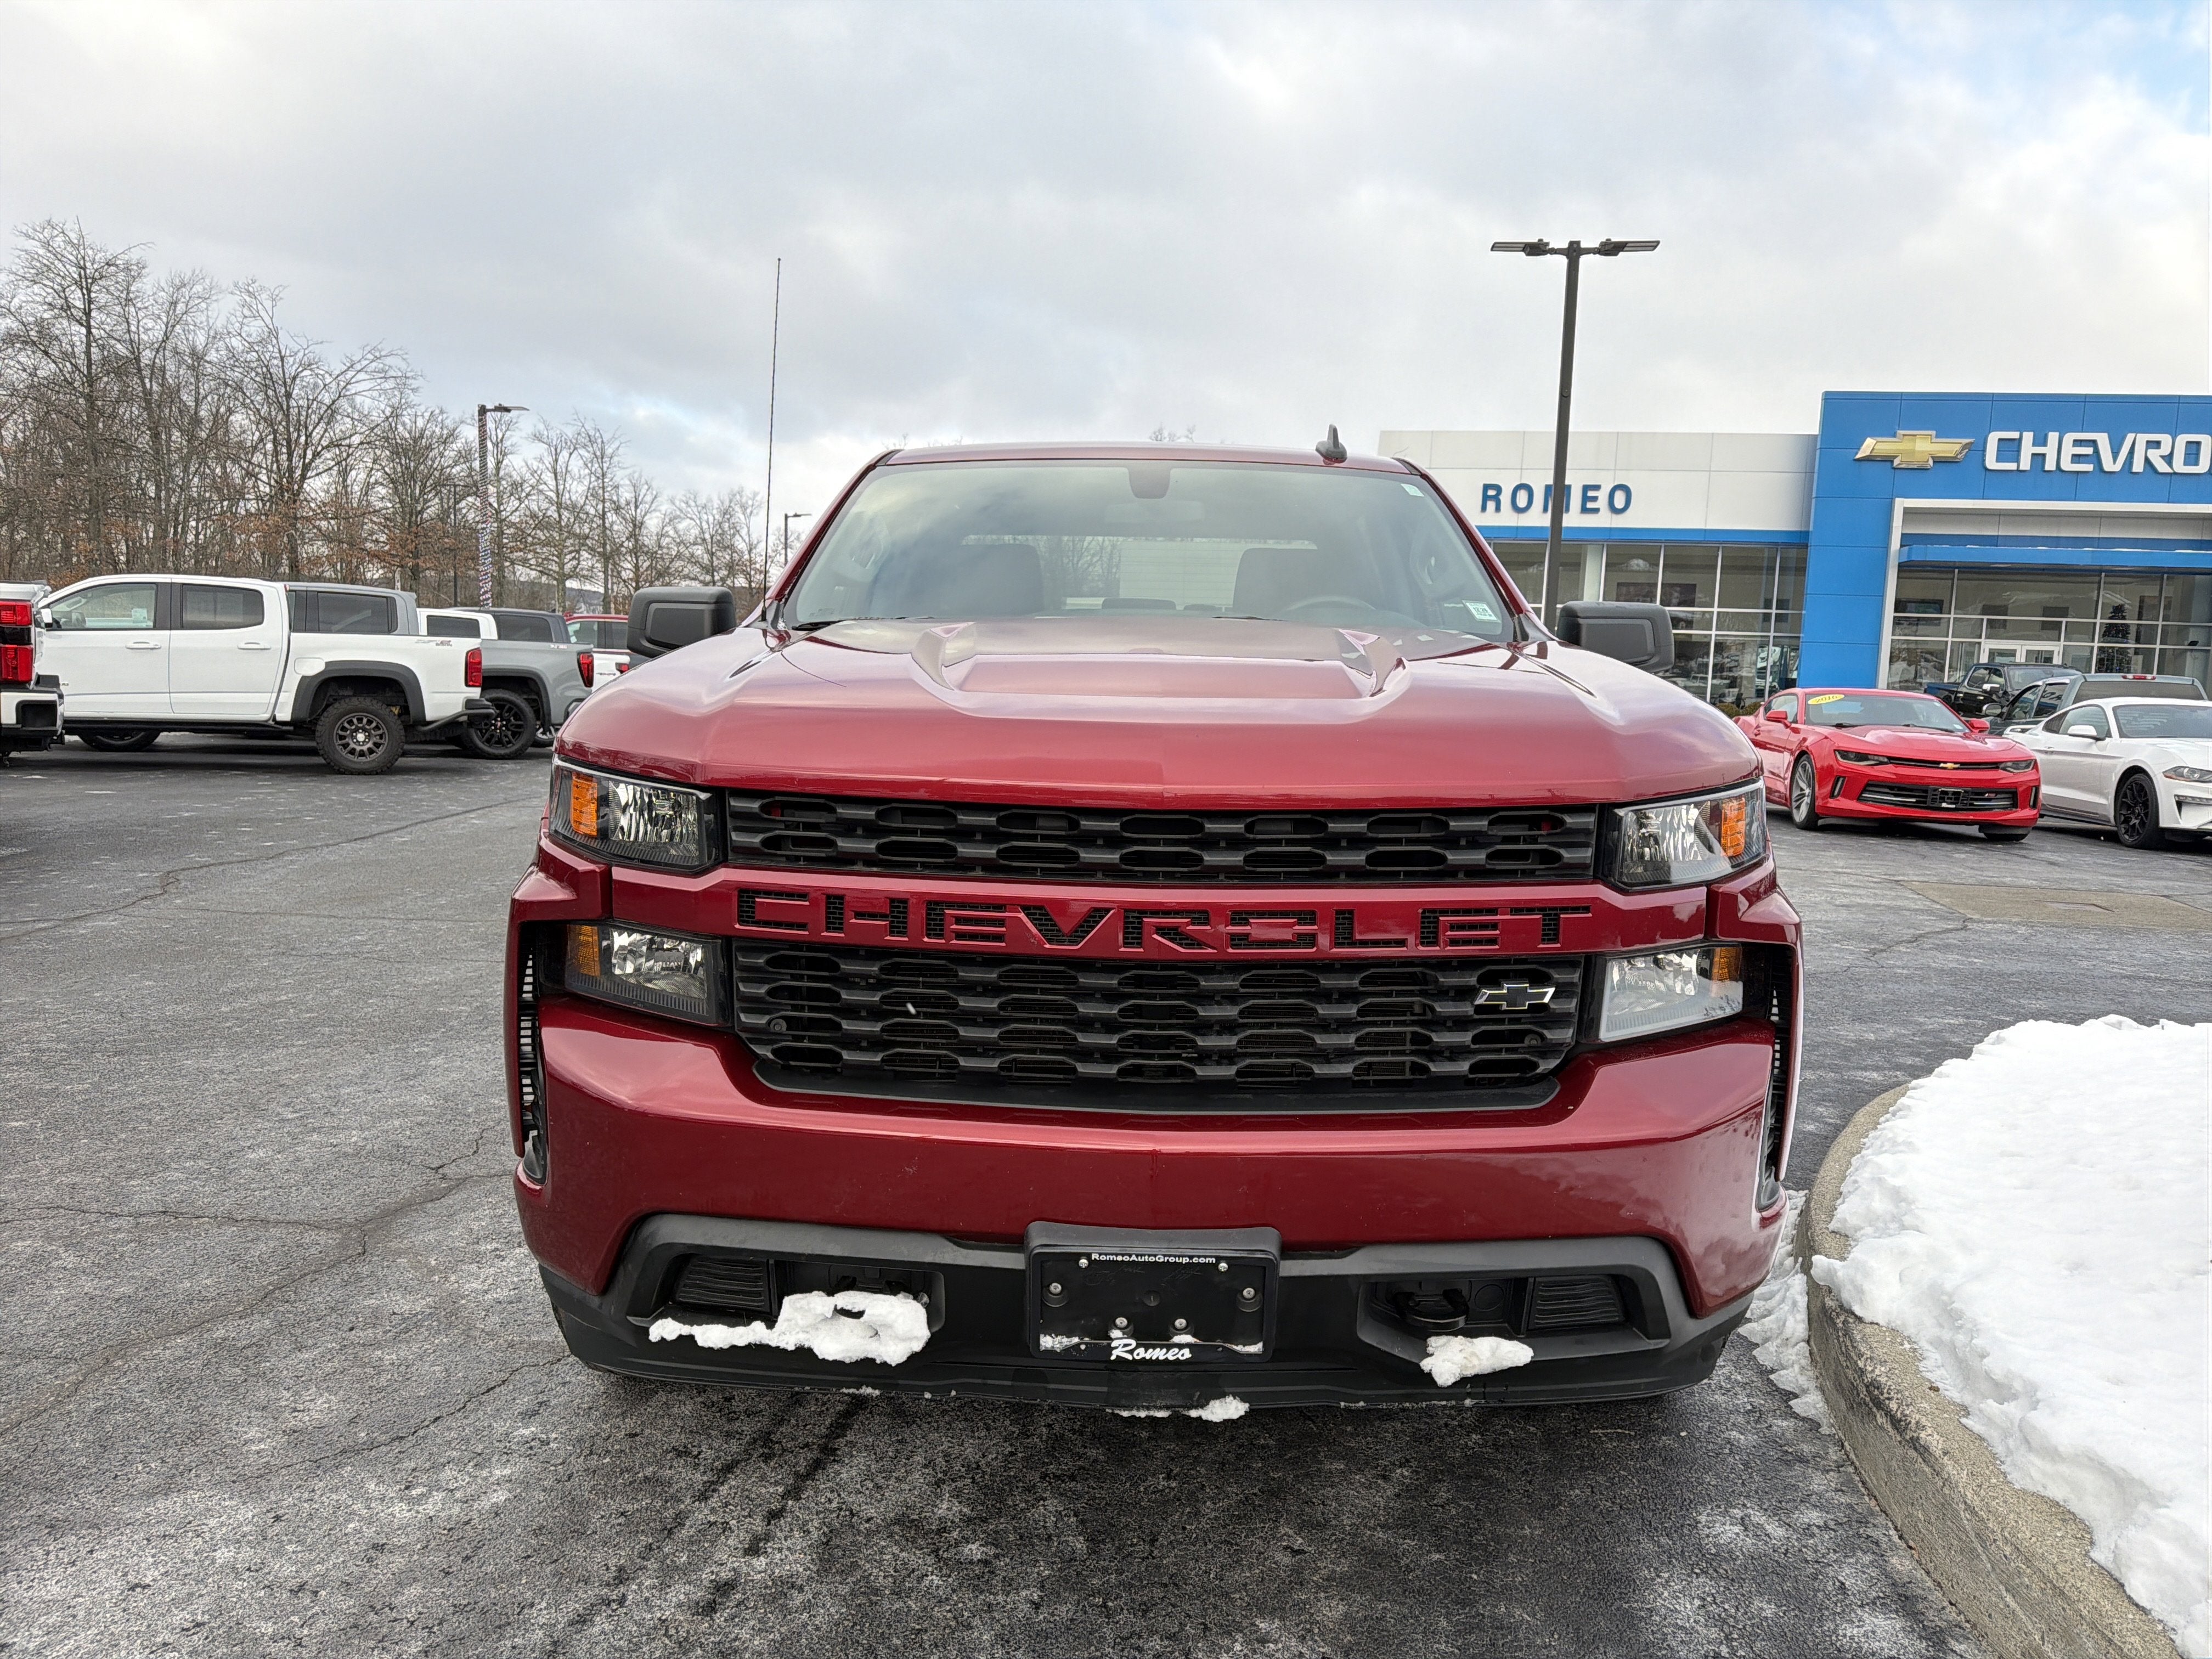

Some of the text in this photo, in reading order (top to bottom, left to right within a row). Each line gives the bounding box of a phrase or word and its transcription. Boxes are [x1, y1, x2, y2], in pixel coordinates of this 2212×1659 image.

[1985, 431, 2212, 473] CHEVRO
[1481, 483, 1632, 515] ROMEO
[736, 888, 1592, 953] CHEVROLET
[1091, 1253, 1216, 1264] RomeoAutoGroup.com
[1110, 1339, 1192, 1361] Romeo
